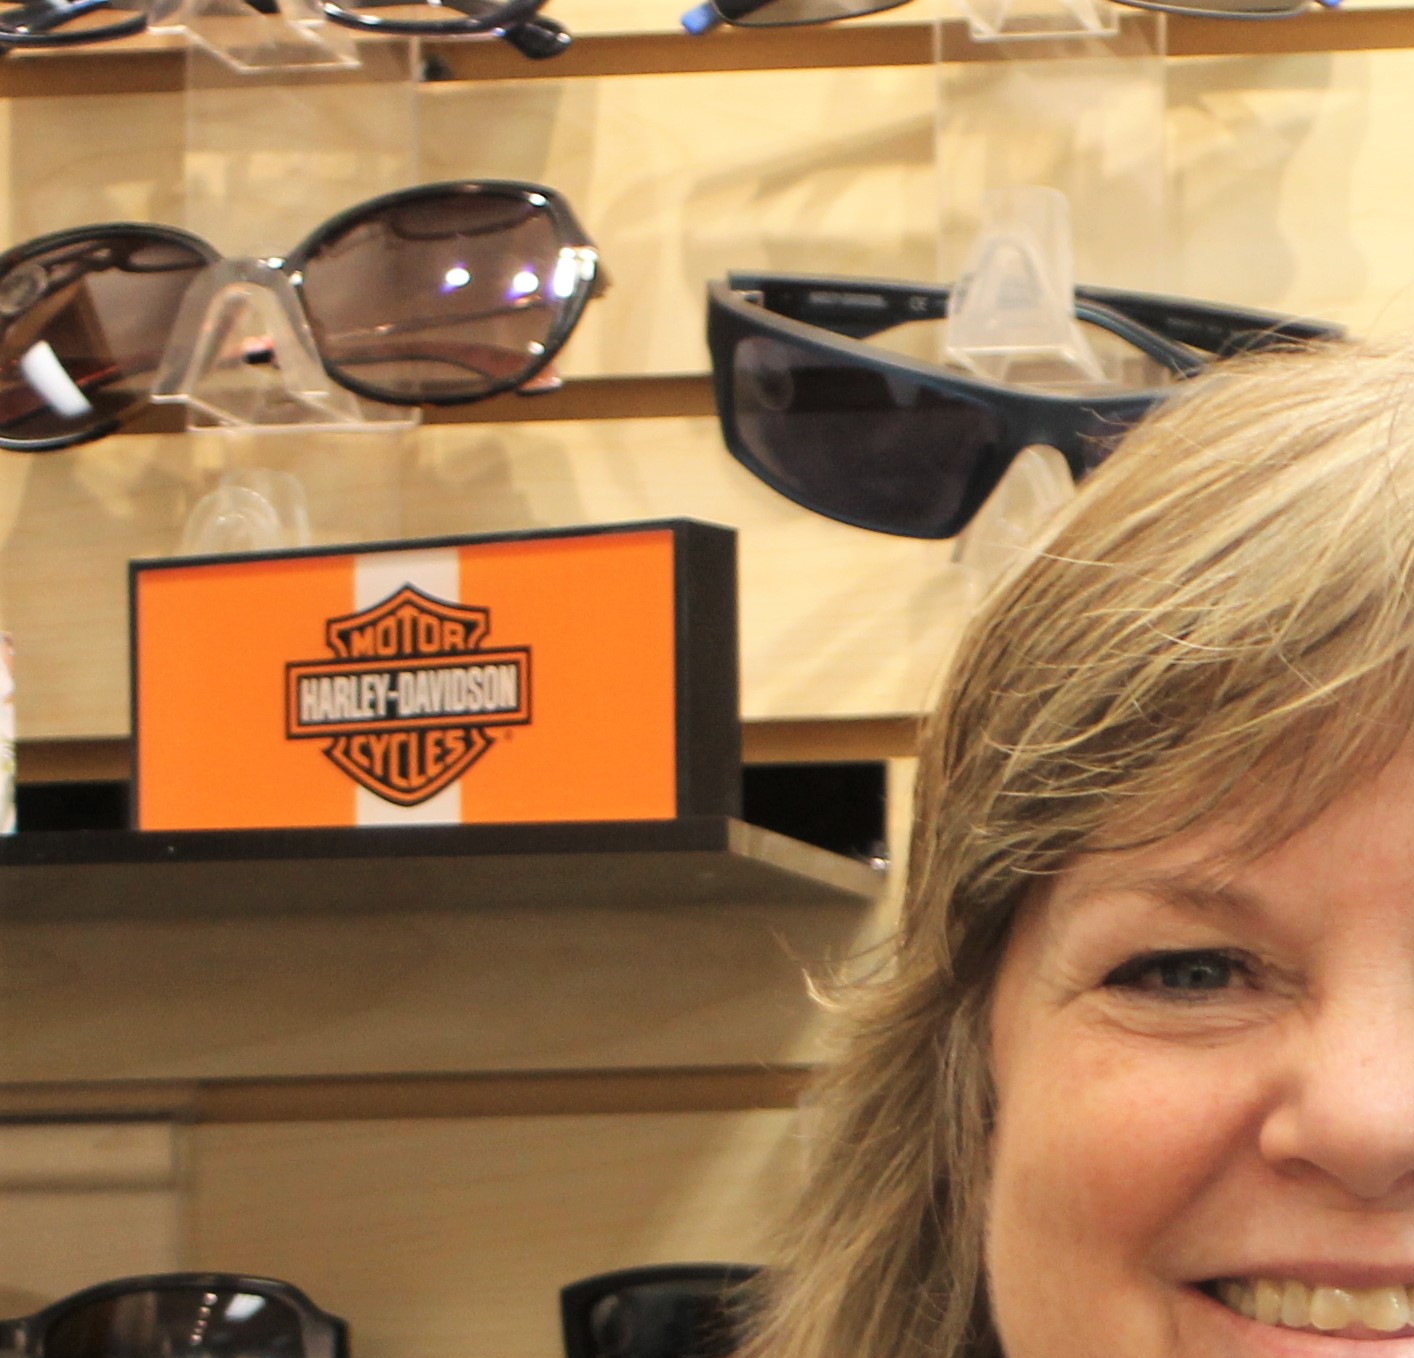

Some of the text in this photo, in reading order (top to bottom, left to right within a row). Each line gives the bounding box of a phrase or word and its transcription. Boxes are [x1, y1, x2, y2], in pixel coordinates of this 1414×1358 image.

[350, 612, 466, 657] MOTOR
[300, 664, 518, 722] HARLEY-DAVIDSON
[350, 728, 466, 786] CYCLES
